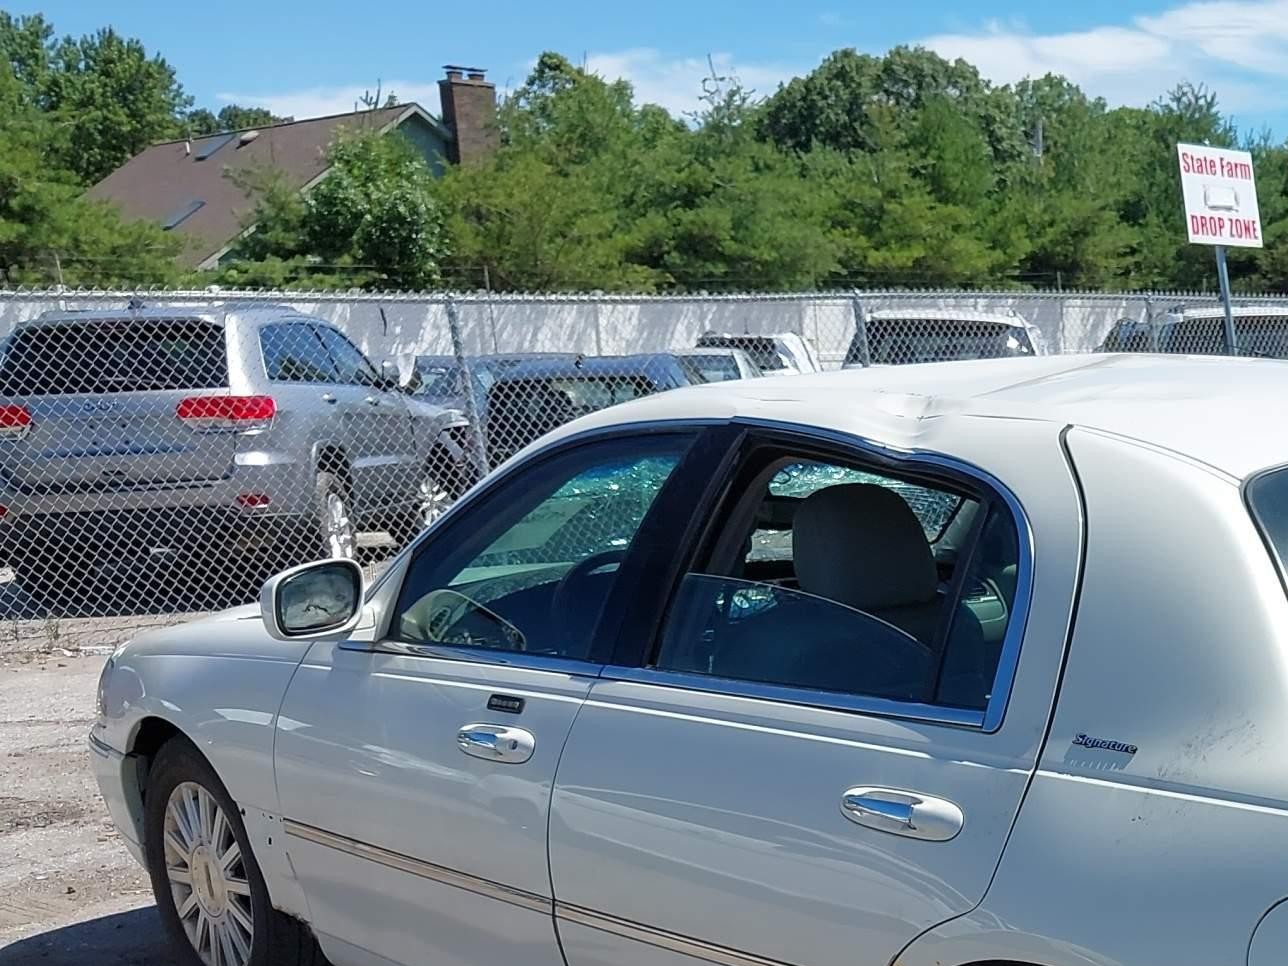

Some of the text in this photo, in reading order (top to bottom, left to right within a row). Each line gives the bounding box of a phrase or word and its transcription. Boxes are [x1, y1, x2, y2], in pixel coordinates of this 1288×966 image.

[1181, 152, 1252, 181] State Farm
[1190, 214, 1259, 240] DROP ZONE
[1072, 734, 1138, 754] Signature
